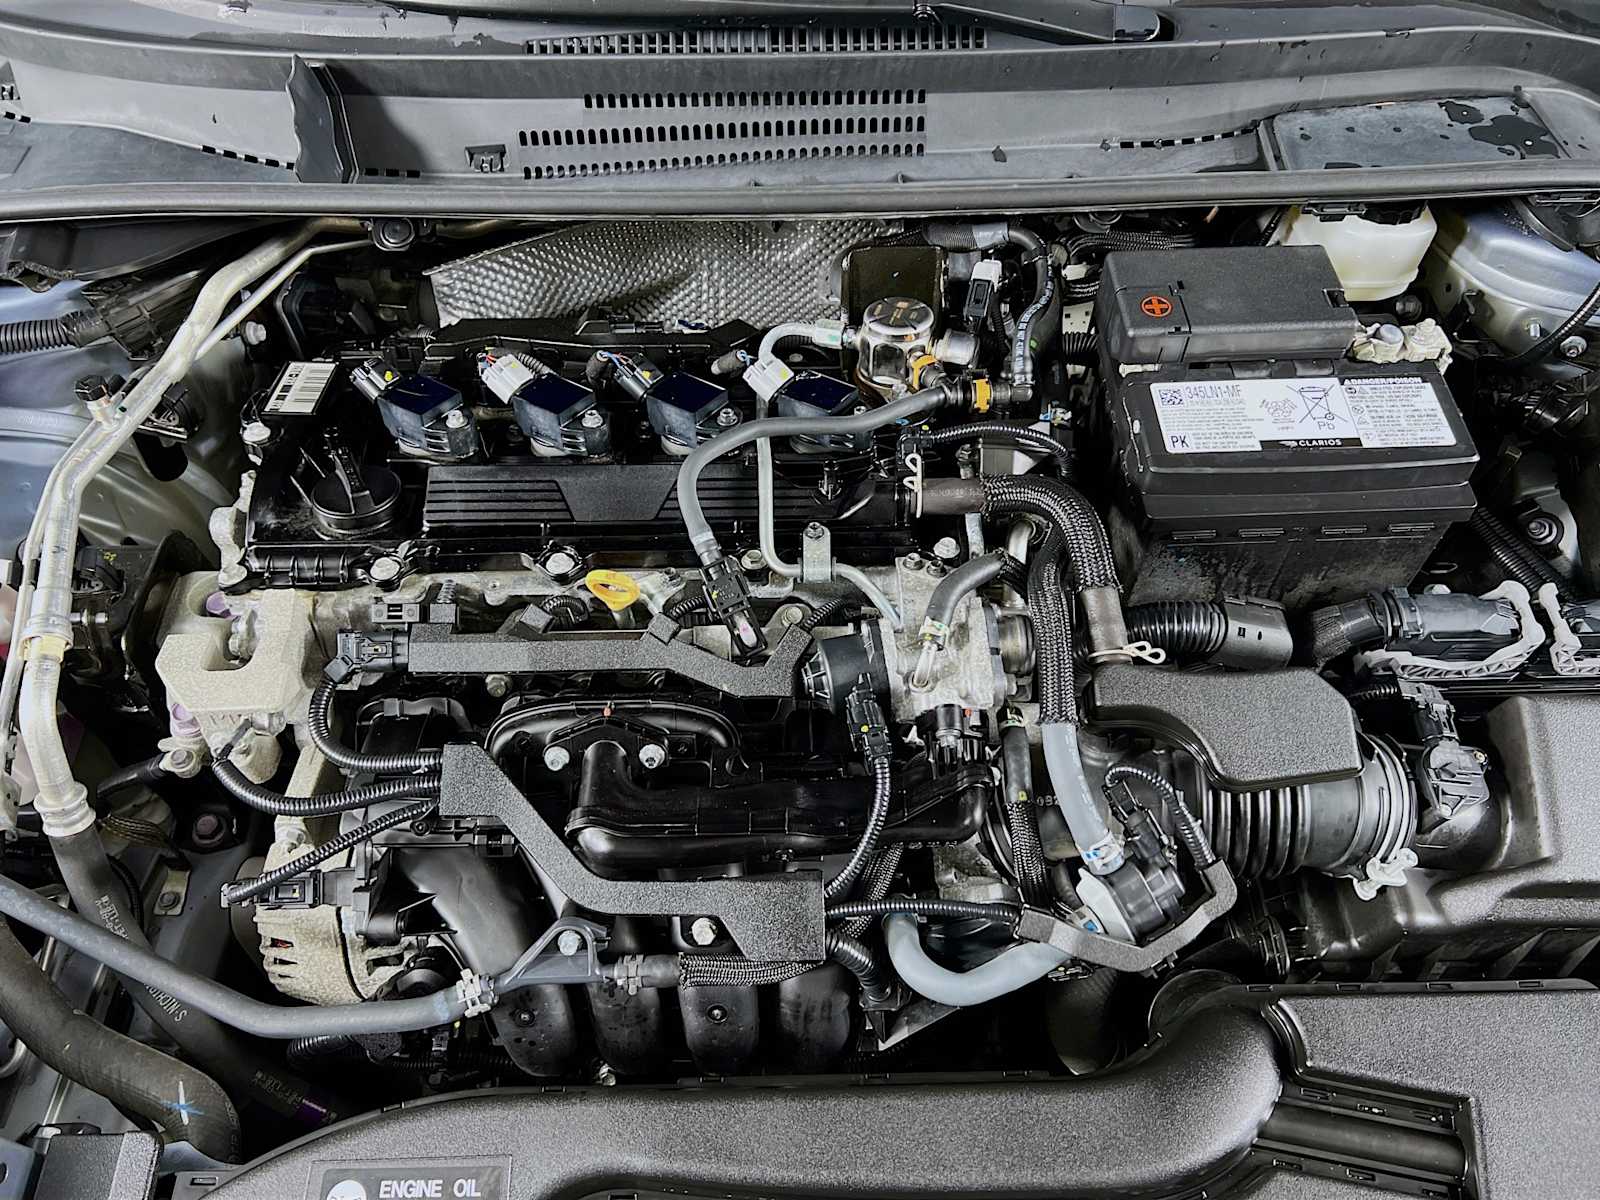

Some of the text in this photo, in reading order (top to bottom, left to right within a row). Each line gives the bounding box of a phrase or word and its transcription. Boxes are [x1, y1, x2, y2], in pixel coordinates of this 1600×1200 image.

[1317, 420, 1336, 431] Pb
[1170, 435, 1190, 449] PK
[1298, 438, 1342, 447] CLARIOS
[379, 1178, 482, 1199] ENGINE OIL
